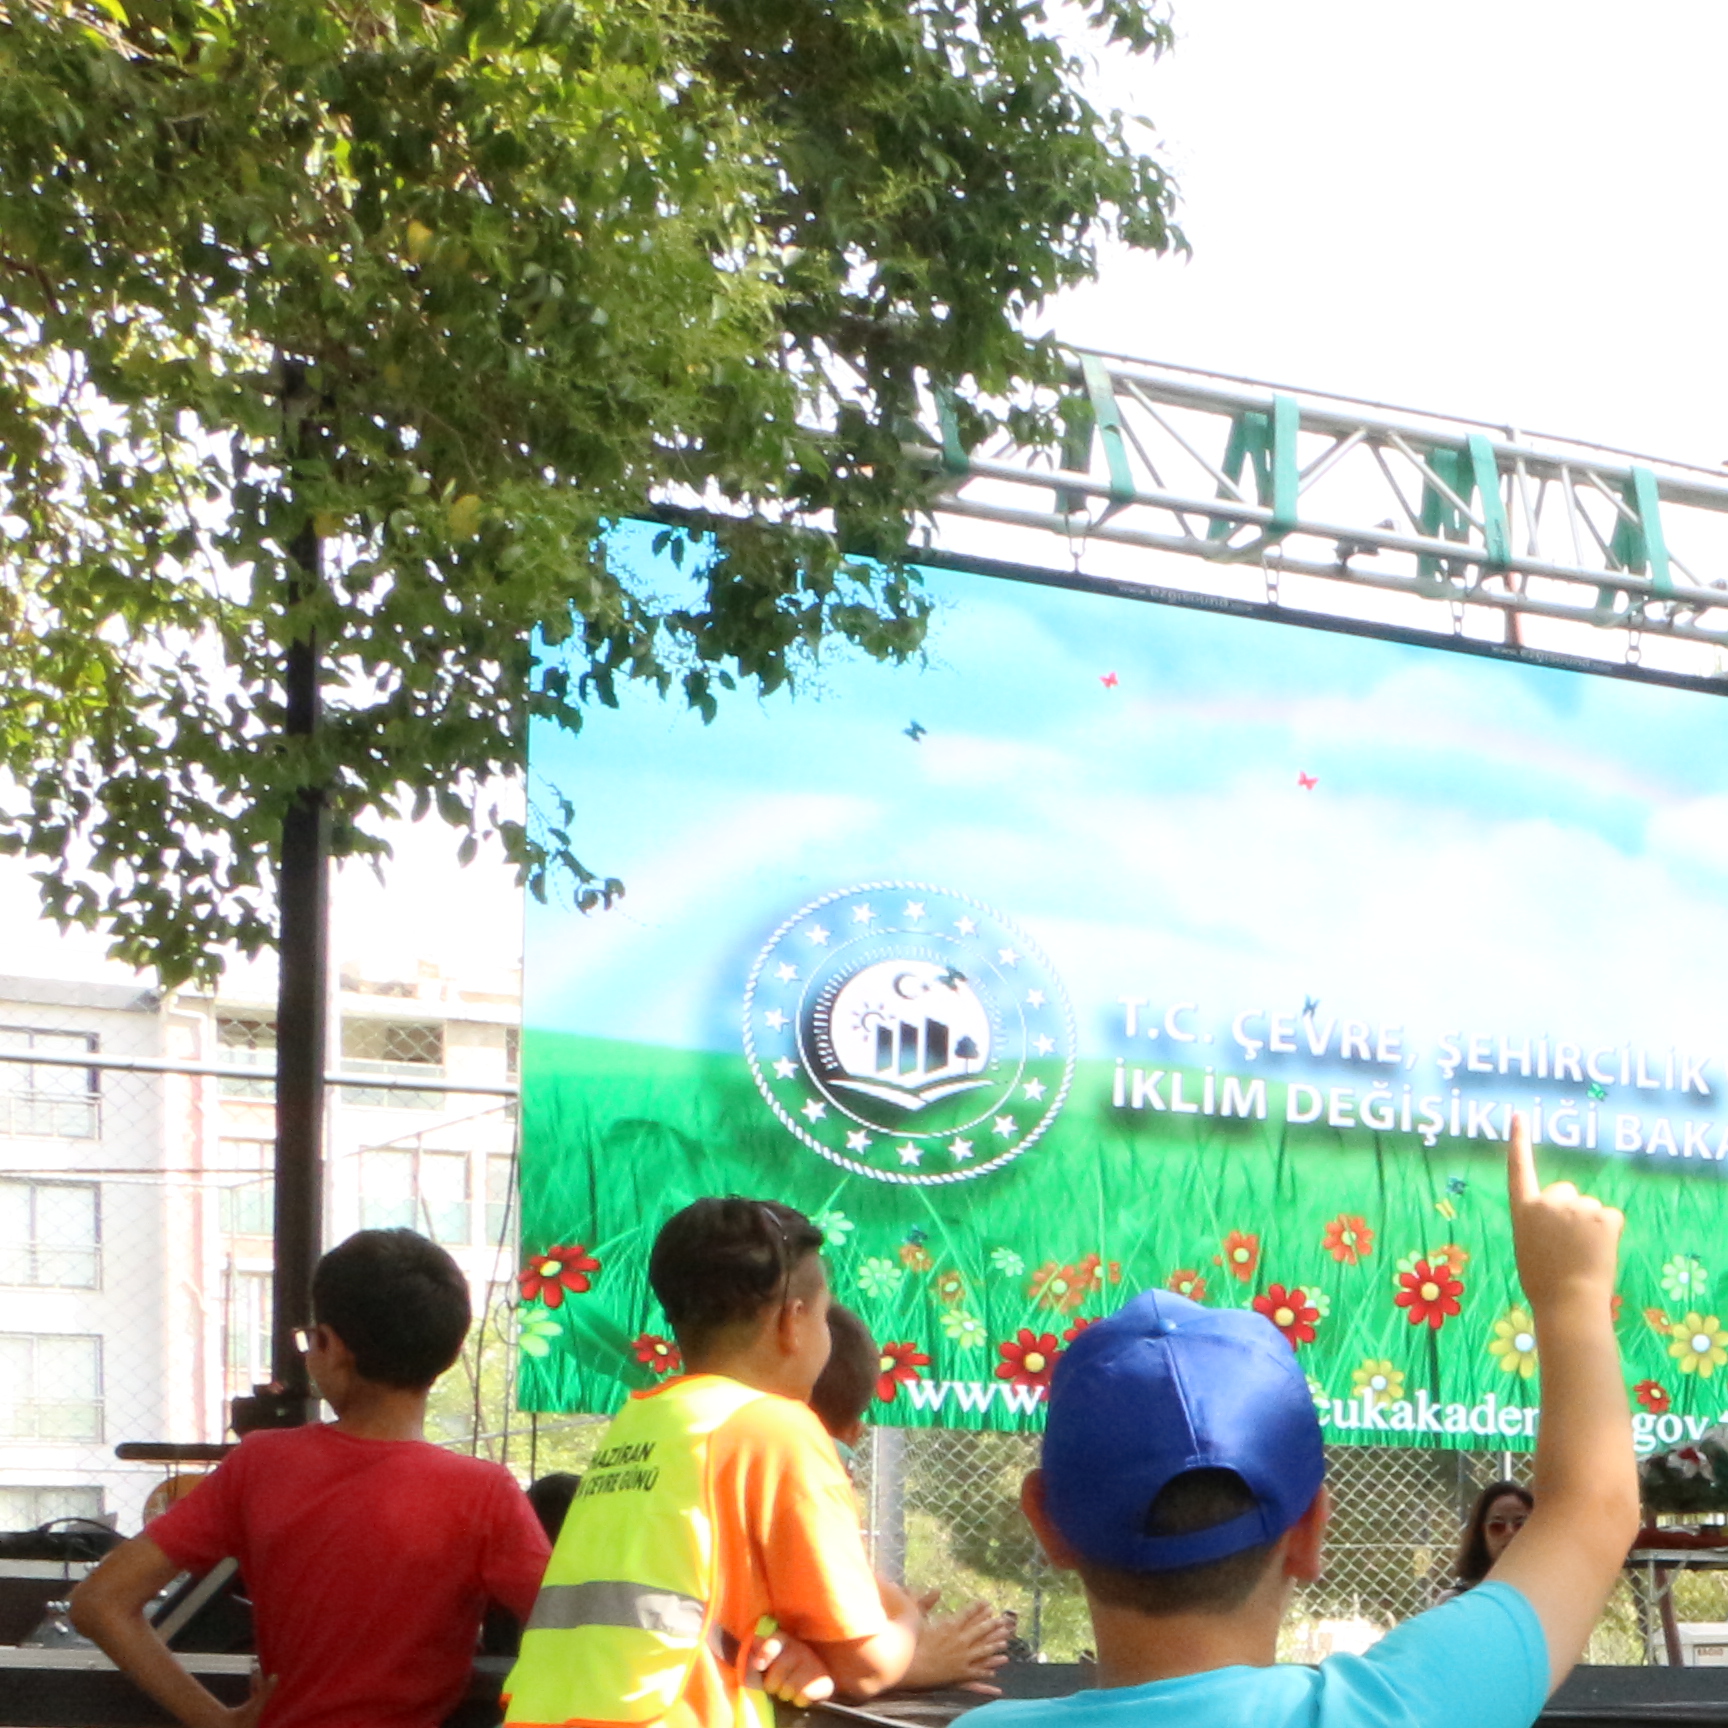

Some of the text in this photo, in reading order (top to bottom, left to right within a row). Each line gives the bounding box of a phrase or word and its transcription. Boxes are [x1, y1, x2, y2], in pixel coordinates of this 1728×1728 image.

[1116, 994, 1215, 1045] T.C.
[1231, 1007, 1418, 1072] ÇEVRE,
[1435, 1028, 1710, 1096] ŞEHİRCİLİK
[1111, 1056, 1268, 1121] İKLİM
